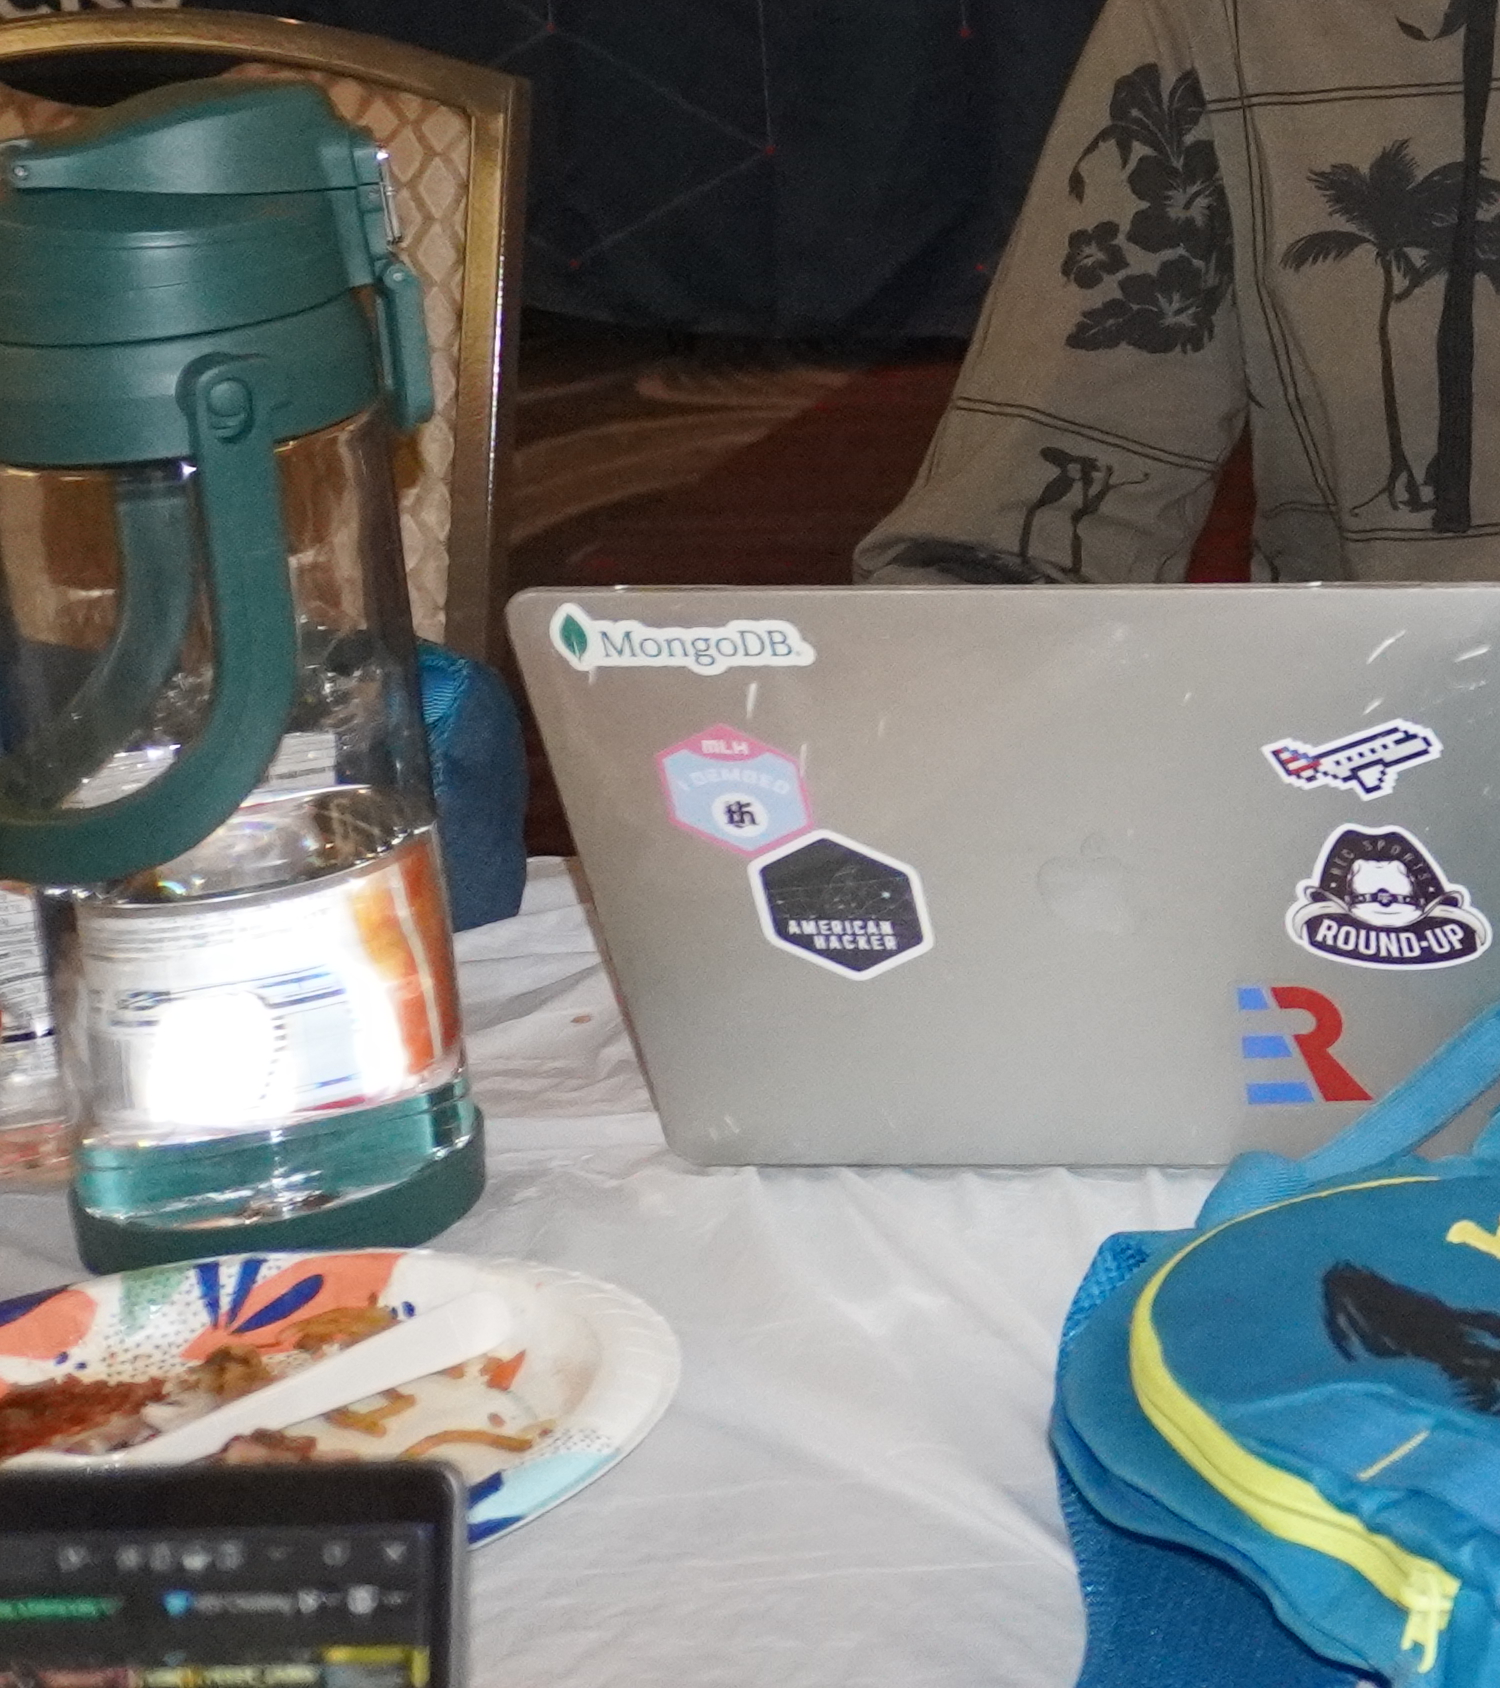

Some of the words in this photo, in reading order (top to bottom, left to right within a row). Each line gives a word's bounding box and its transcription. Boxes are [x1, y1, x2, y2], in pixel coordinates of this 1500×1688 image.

[701, 740, 748, 755] MLH
[787, 920, 895, 935] AMERICAN
[813, 935, 898, 950] HACKER
[1316, 919, 1464, 957] ROUND-UP
